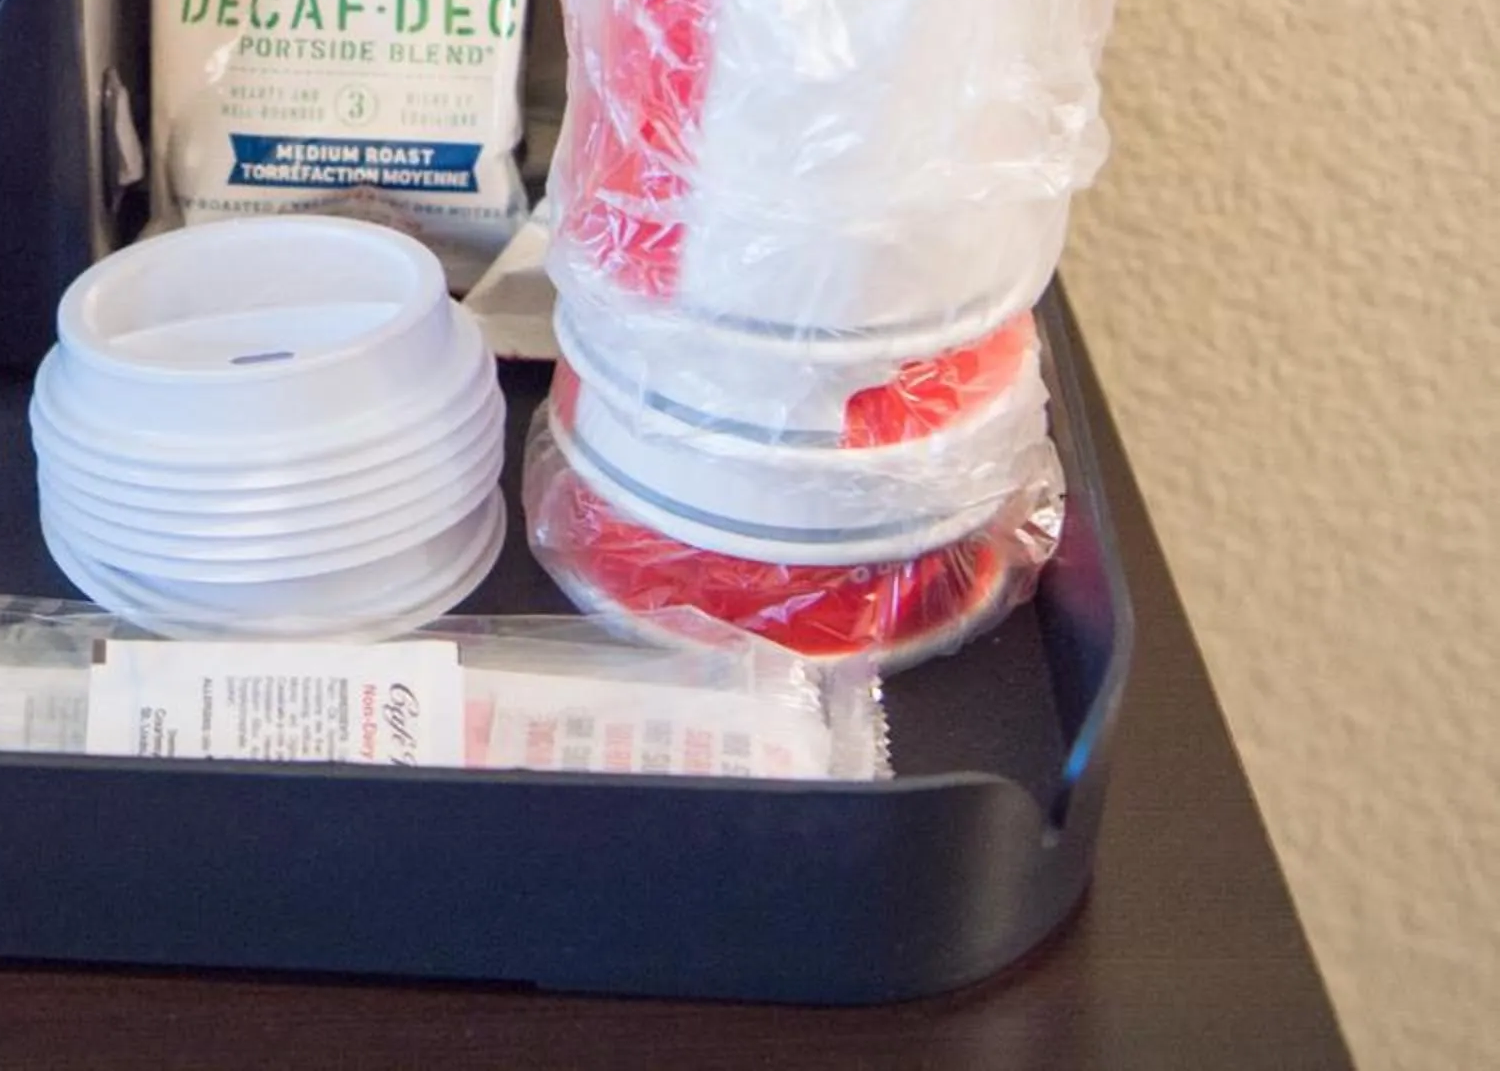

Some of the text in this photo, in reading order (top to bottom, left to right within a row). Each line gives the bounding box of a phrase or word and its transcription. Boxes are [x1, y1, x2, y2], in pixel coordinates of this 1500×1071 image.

[238, 35, 374, 61] PORTSIDE
[347, 92, 365, 119] 3
[275, 143, 436, 166] MEDIUM ROAST
[382, 168, 472, 188] MOYENNE
[360, 683, 378, 761] Non-Dairy
